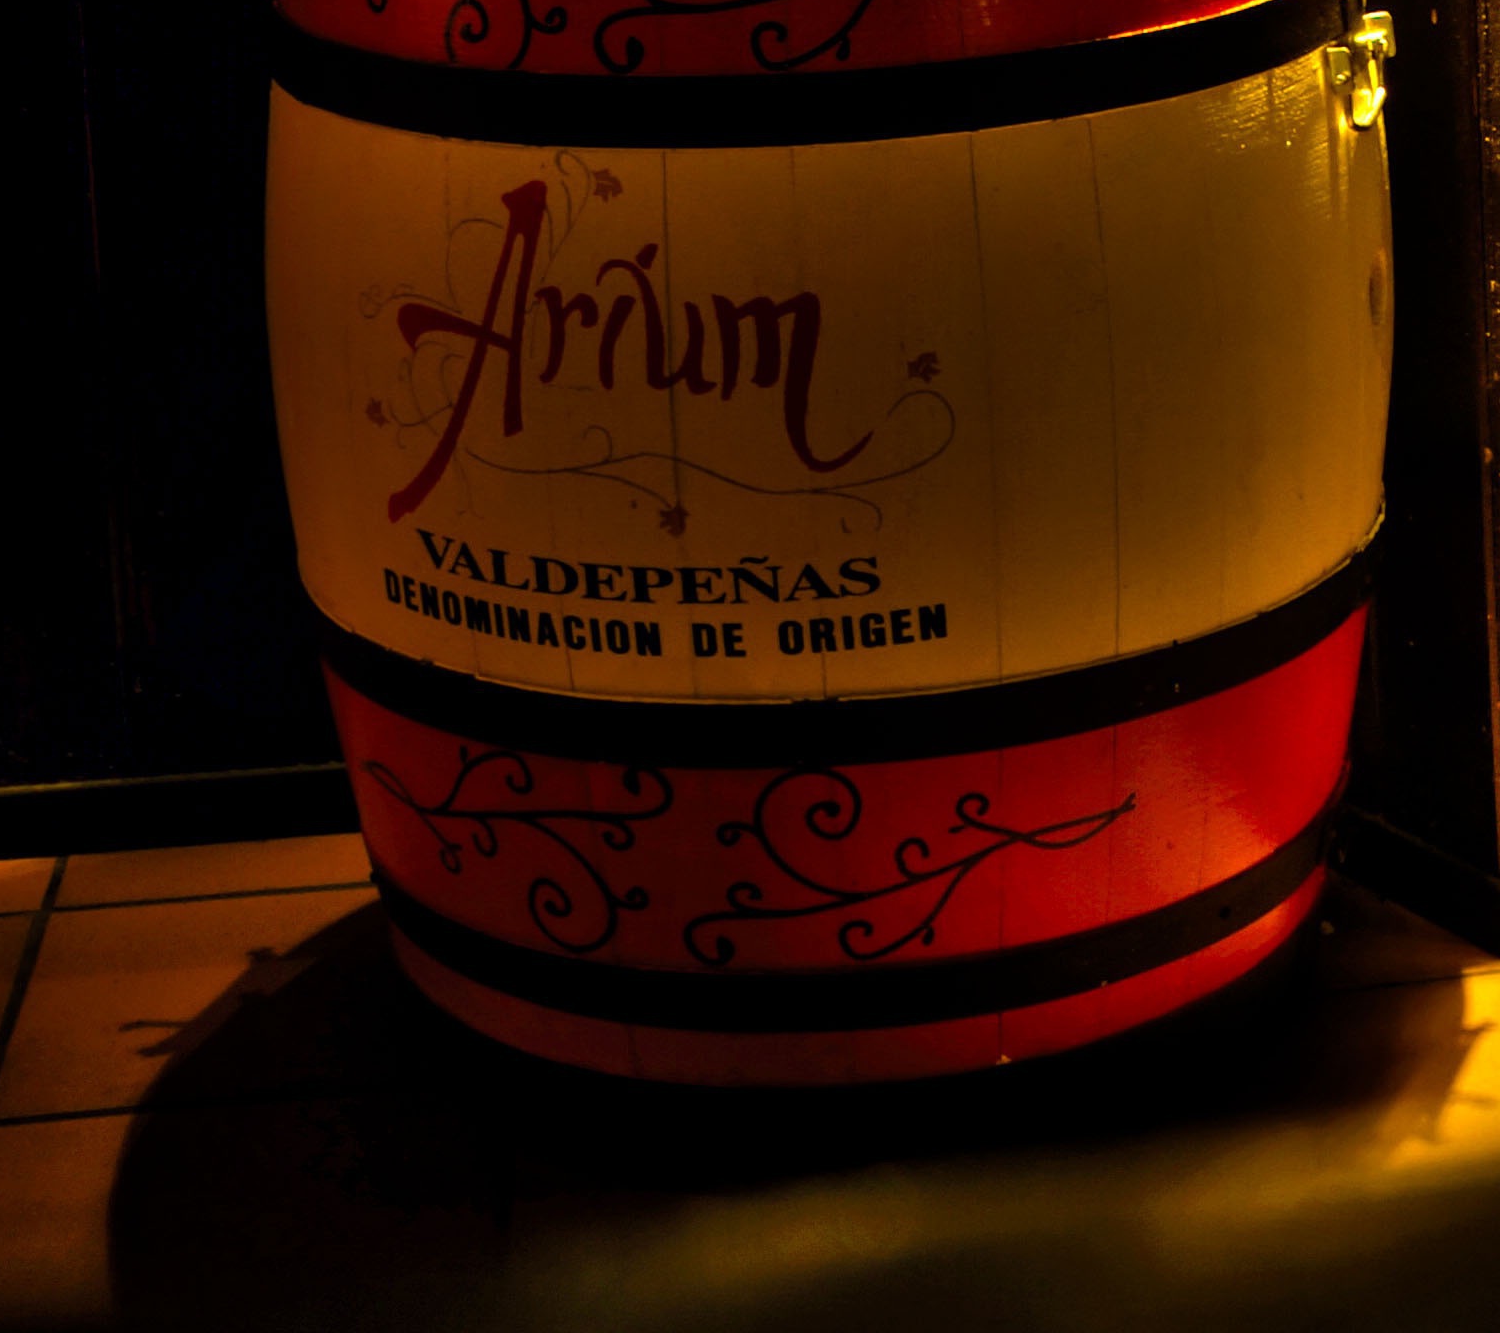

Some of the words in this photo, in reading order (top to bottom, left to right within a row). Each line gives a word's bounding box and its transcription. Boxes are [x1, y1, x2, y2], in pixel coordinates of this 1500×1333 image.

[415, 529, 882, 606] VALDEPEÑAS
[383, 568, 663, 658] DENOMINACION
[691, 621, 747, 658] DE
[777, 603, 949, 658] ORIGEN
